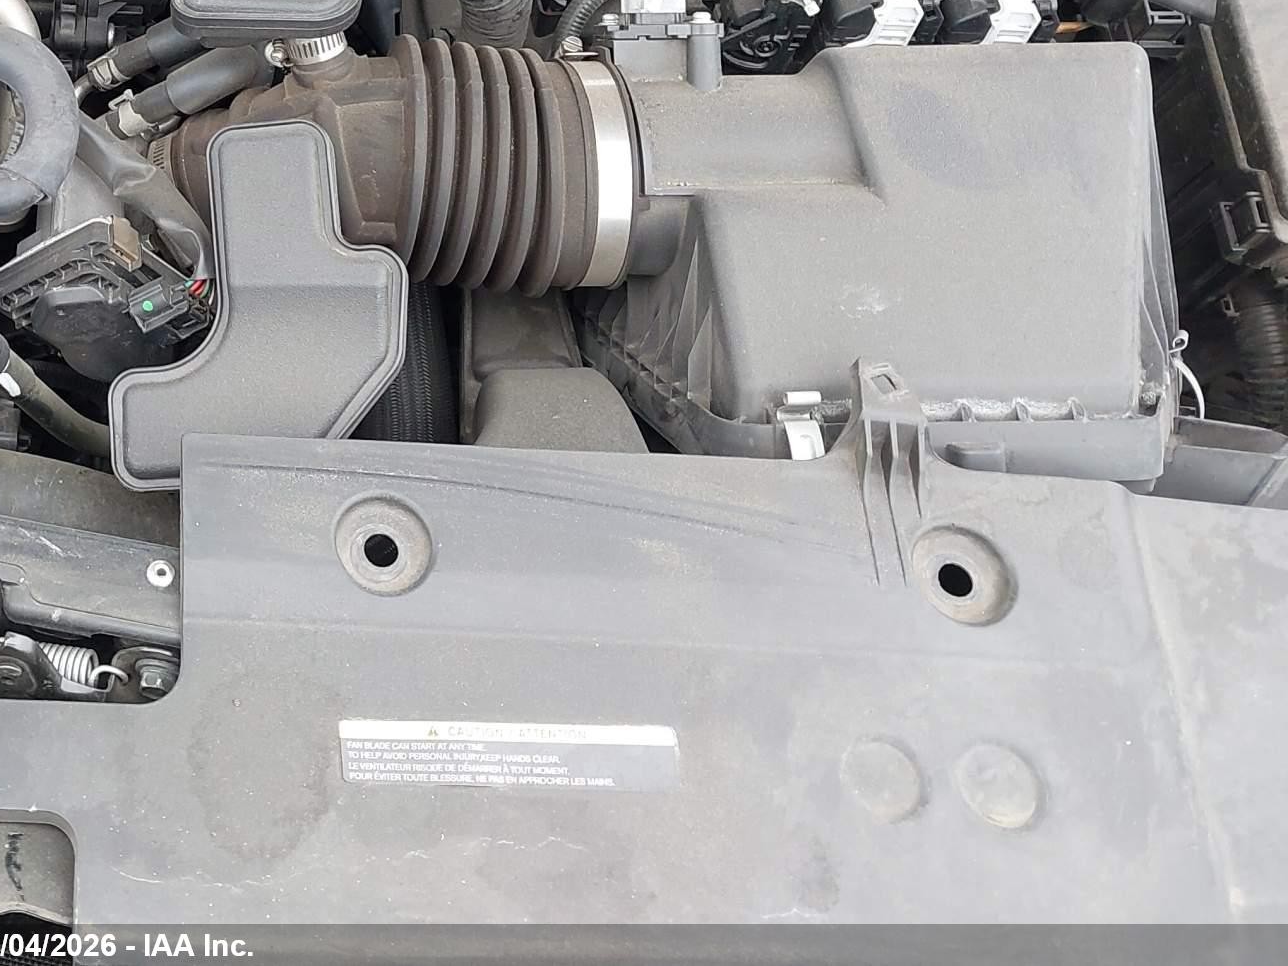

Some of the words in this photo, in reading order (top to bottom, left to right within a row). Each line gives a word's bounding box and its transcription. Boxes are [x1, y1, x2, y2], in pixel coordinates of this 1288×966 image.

[448, 726, 503, 738] CAUTION
[519, 727, 586, 739] ATTENTION
[347, 741, 364, 750] FAN
[365, 741, 391, 750] BLADE
[392, 742, 410, 751] CAN
[412, 742, 436, 751] START
[438, 743, 448, 751] AT
[449, 743, 465, 751] ANY
[348, 752, 359, 760] TO
[360, 752, 382, 760] HELP
[383, 752, 408, 761] AVOID
[409, 753, 452, 761] PERSONAL
[502, 754, 532, 763] HANDS
[348, 762, 359, 770] LE
[360, 762, 412, 772] VENTILATEUR
[413, 763, 443, 773] RISQUE
[445, 764, 457, 772] DE
[458, 762, 502, 773] DÉMARRER
[510, 766, 531, 774] TOUT
[532, 766, 570, 775] MOMENT.
[349, 772, 374, 780] POUR
[374, 770, 402, 781] ÉVITER
[402, 773, 429, 782] TOUTE
[430, 774, 475, 783] BLESSURE,
[476, 775, 488, 783] NE
[489, 776, 504, 784] PAS
[506, 776, 518, 784] EN
[519, 777, 569, 785] APPROCHER
[570, 778, 587, 786] LES
